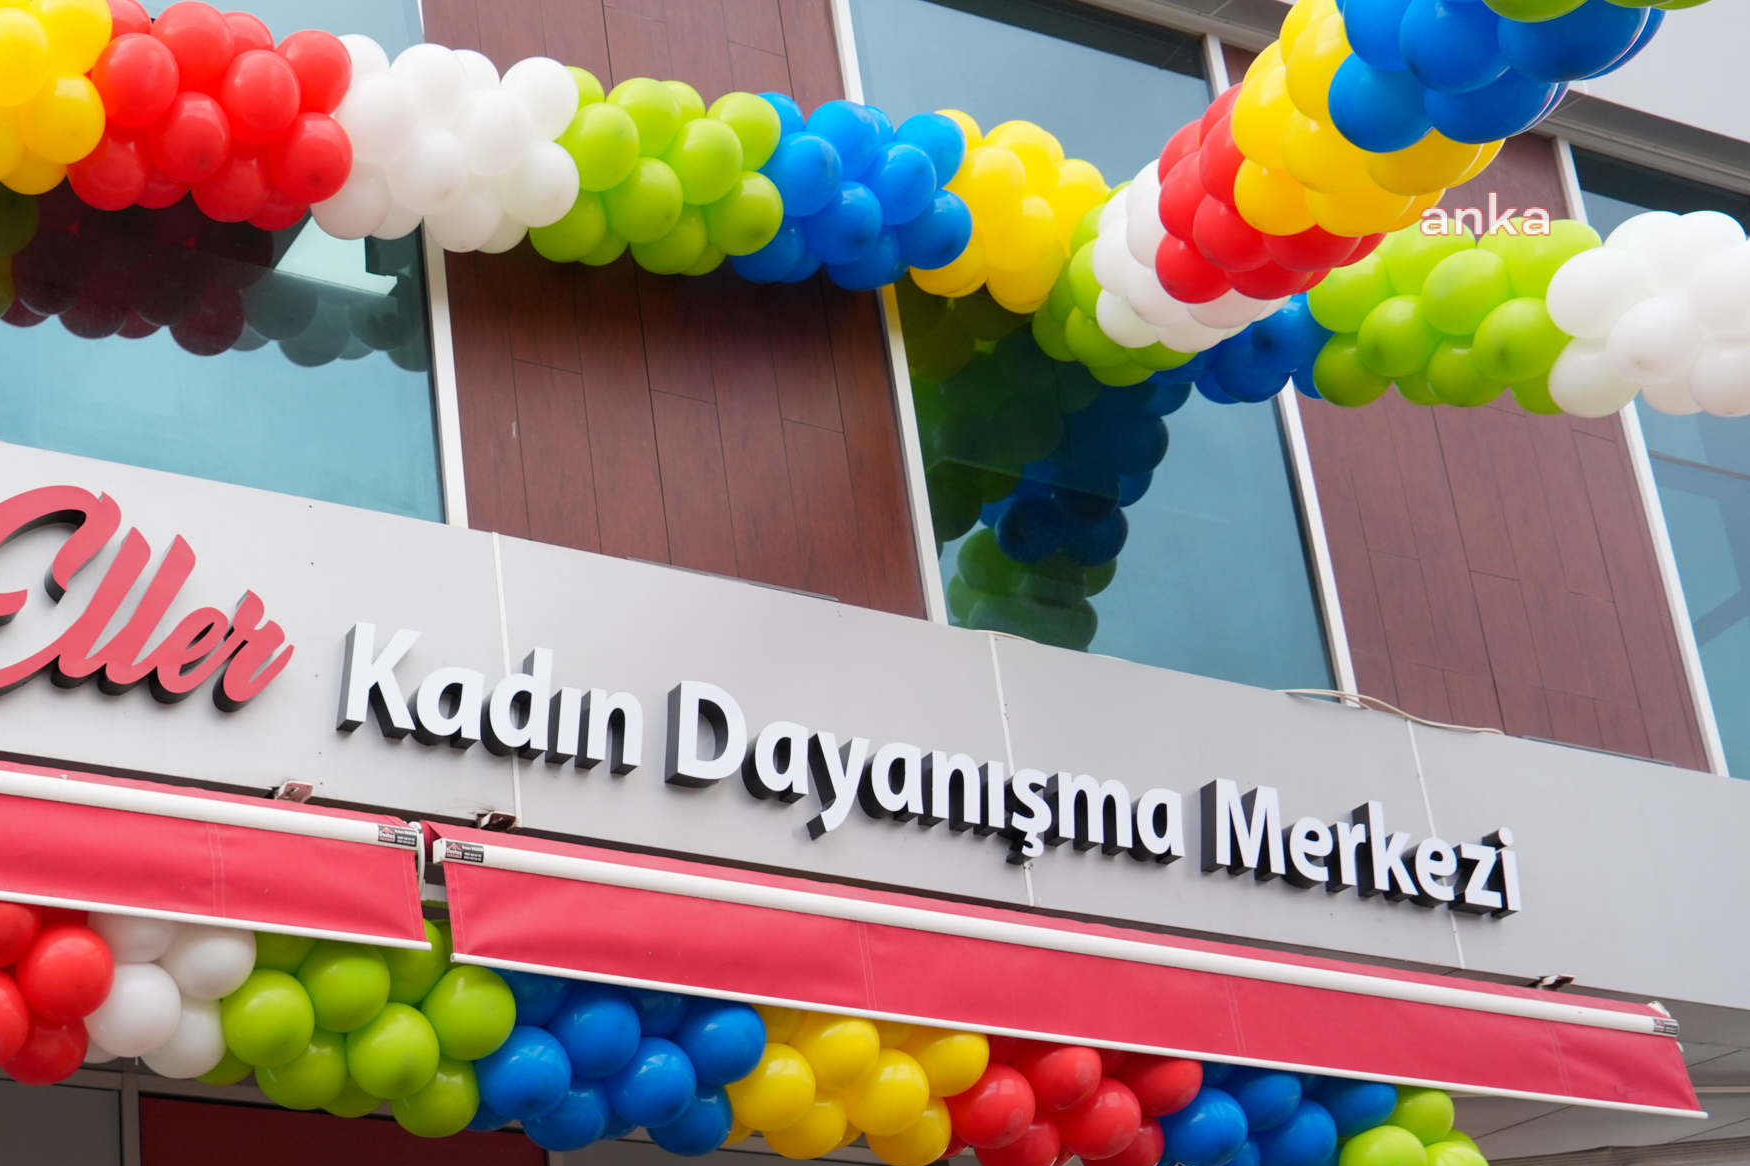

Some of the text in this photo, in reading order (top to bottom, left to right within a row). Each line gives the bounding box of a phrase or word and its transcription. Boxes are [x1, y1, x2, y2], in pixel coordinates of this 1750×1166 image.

[335, 621, 643, 776] Kadın
[664, 680, 1184, 866] Dayanışma
[1200, 777, 1523, 920] Merkezi
